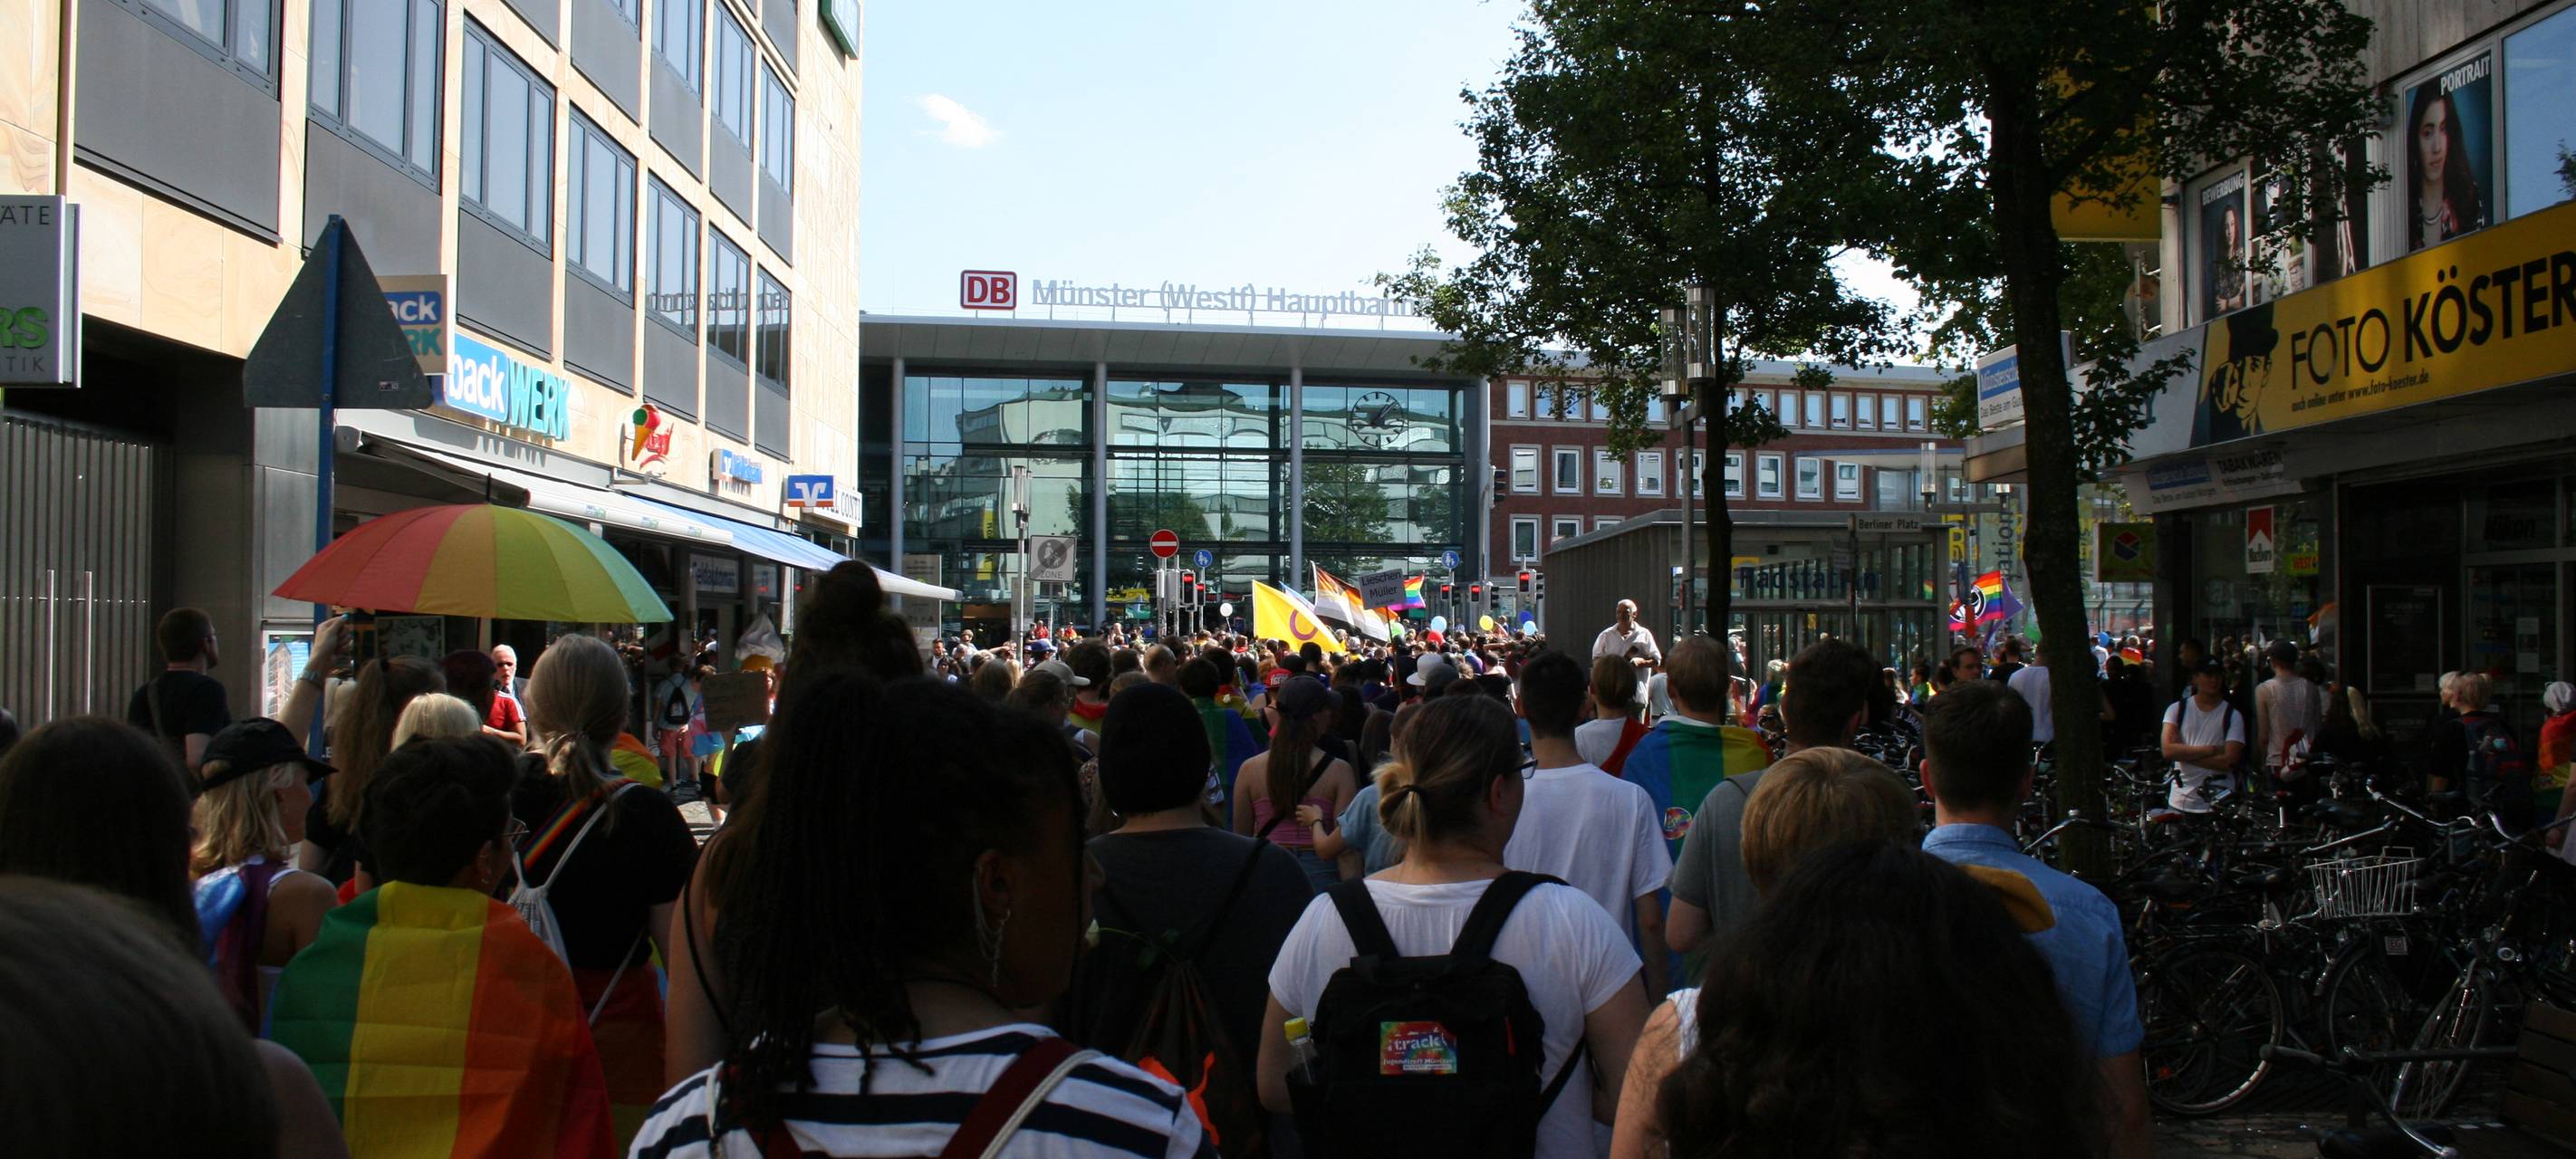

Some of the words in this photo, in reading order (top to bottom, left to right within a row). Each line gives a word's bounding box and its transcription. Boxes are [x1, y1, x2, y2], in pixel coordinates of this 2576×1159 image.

[2440, 55, 2491, 96] PORTRAIT
[2202, 171, 2244, 206] BEWERBUNG
[967, 276, 1011, 304] DB
[1033, 279, 1150, 307] Münster
[1159, 280, 1256, 314] (Westf)
[1267, 286, 1418, 321] Hauptbahn
[388, 295, 437, 321] ack
[2291, 308, 2390, 390] FOTO
[2403, 250, 2576, 362] KÖSTER
[408, 329, 443, 355] RK
[449, 354, 505, 413] back
[508, 357, 572, 442] WERK
[2308, 393, 2327, 408] online
[2328, 390, 2346, 405] unter
[2348, 368, 2430, 399] www.foto-koester.de
[1859, 520, 1892, 530] Berliner
[1897, 519, 1919, 530] Platz
[1361, 571, 1401, 587] Lieschen
[1370, 586, 1398, 598] Müller
